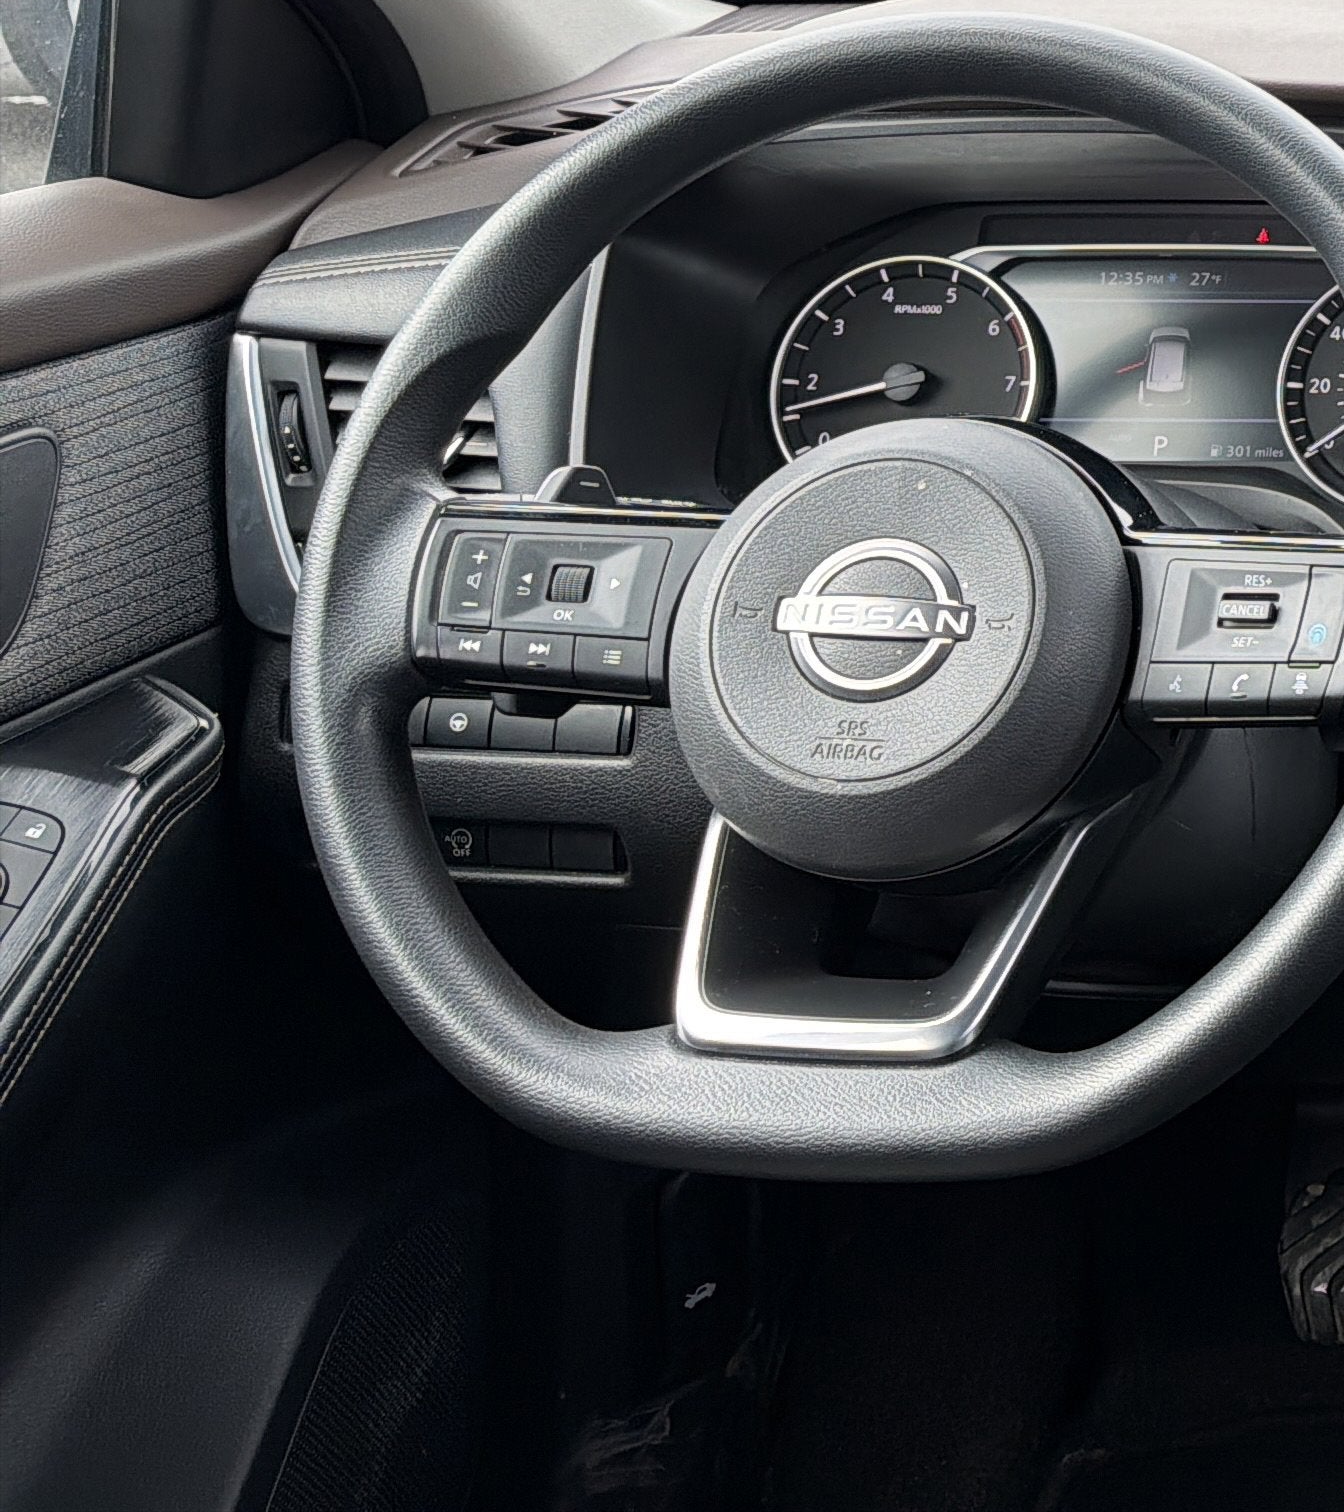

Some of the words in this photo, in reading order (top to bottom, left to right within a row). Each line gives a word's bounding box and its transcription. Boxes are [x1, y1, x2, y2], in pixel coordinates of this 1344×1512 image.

[1099, 271, 1145, 287] 12:35
[1146, 274, 1165, 286] PM
[881, 287, 895, 303] 4
[945, 287, 957, 304] 5
[832, 318, 845, 336] 3
[987, 320, 1000, 336] 6
[806, 373, 819, 390] 2
[1003, 375, 1017, 392] 7
[1308, 378, 1331, 394] 20
[1152, 435, 1169, 457] P
[1225, 445, 1252, 458] 301
[1254, 447, 1284, 458] miles
[1244, 574, 1273, 587] RES+
[552, 609, 575, 622] OK
[1222, 603, 1266, 617] CANCEL
[782, 602, 970, 635] NISSAN
[835, 719, 871, 737] SRS
[809, 742, 885, 762] AIRBAG
